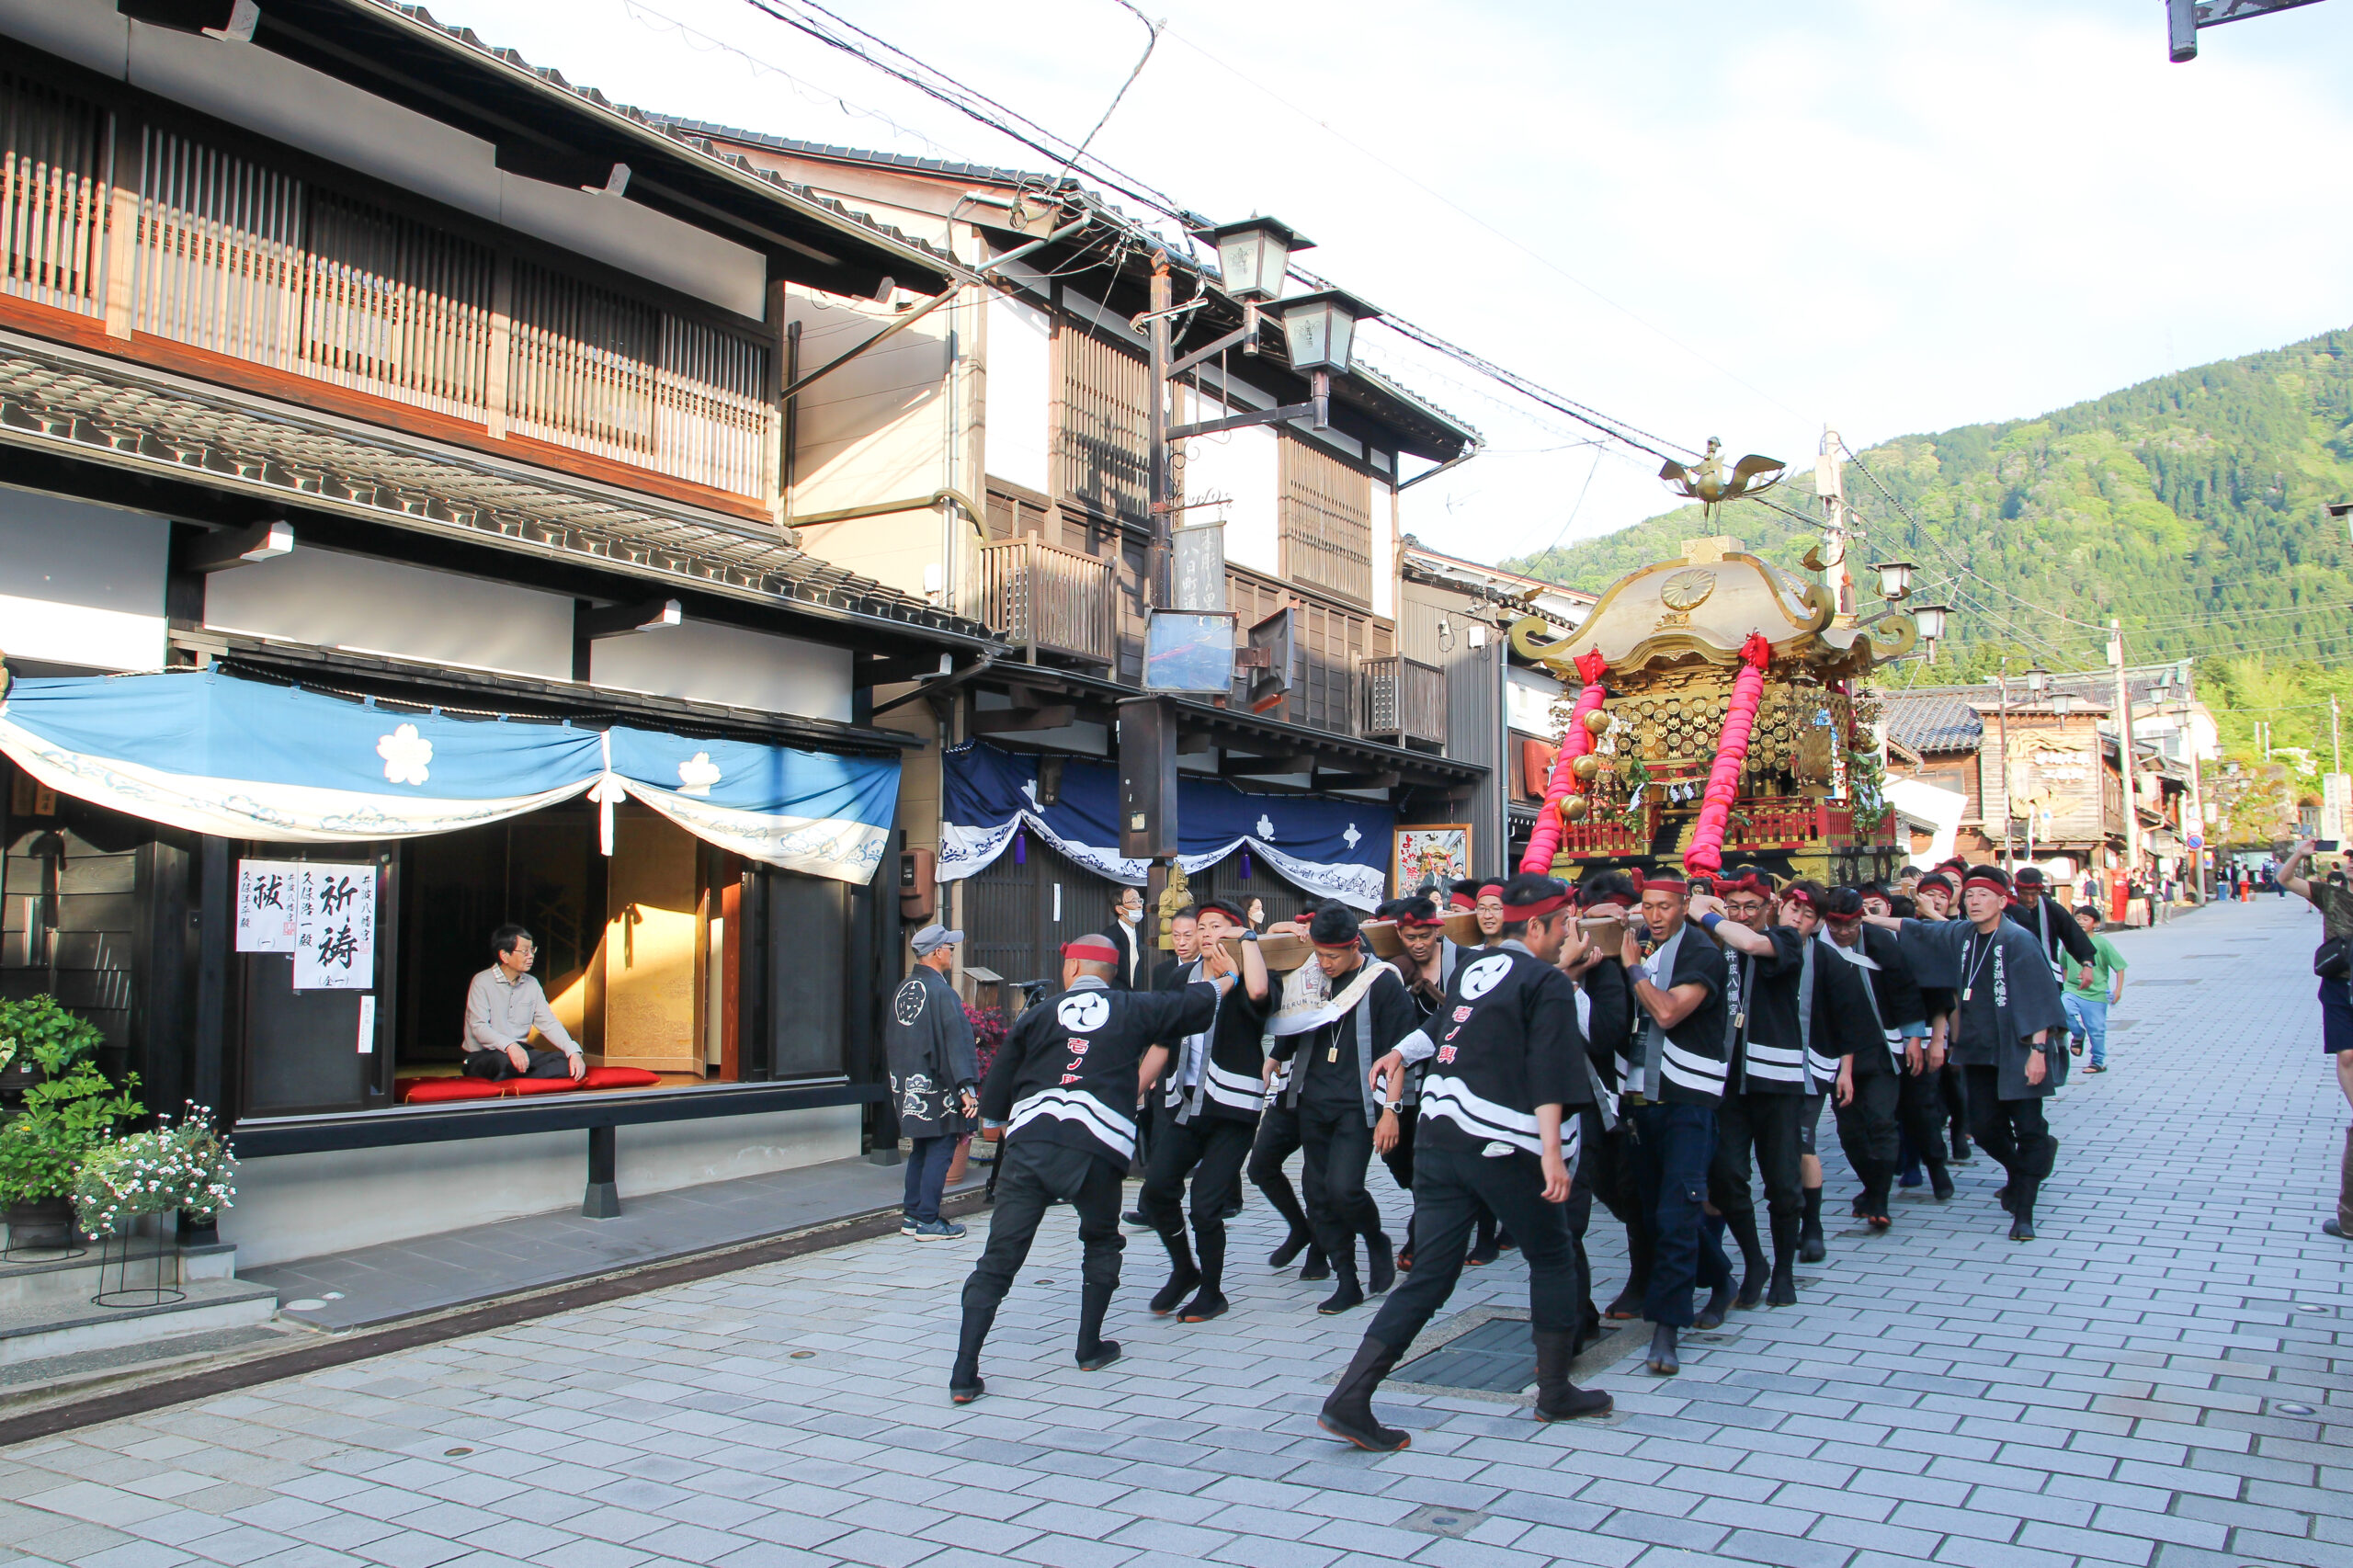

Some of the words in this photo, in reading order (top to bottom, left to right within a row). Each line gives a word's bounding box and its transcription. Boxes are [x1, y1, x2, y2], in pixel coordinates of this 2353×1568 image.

[1201, 528, 1216, 610] 木彫りの里
[287, 874, 295, 922] 井波八幡宮
[317, 876, 358, 970] 祈祷
[360, 874, 373, 941] 井波八幡宮
